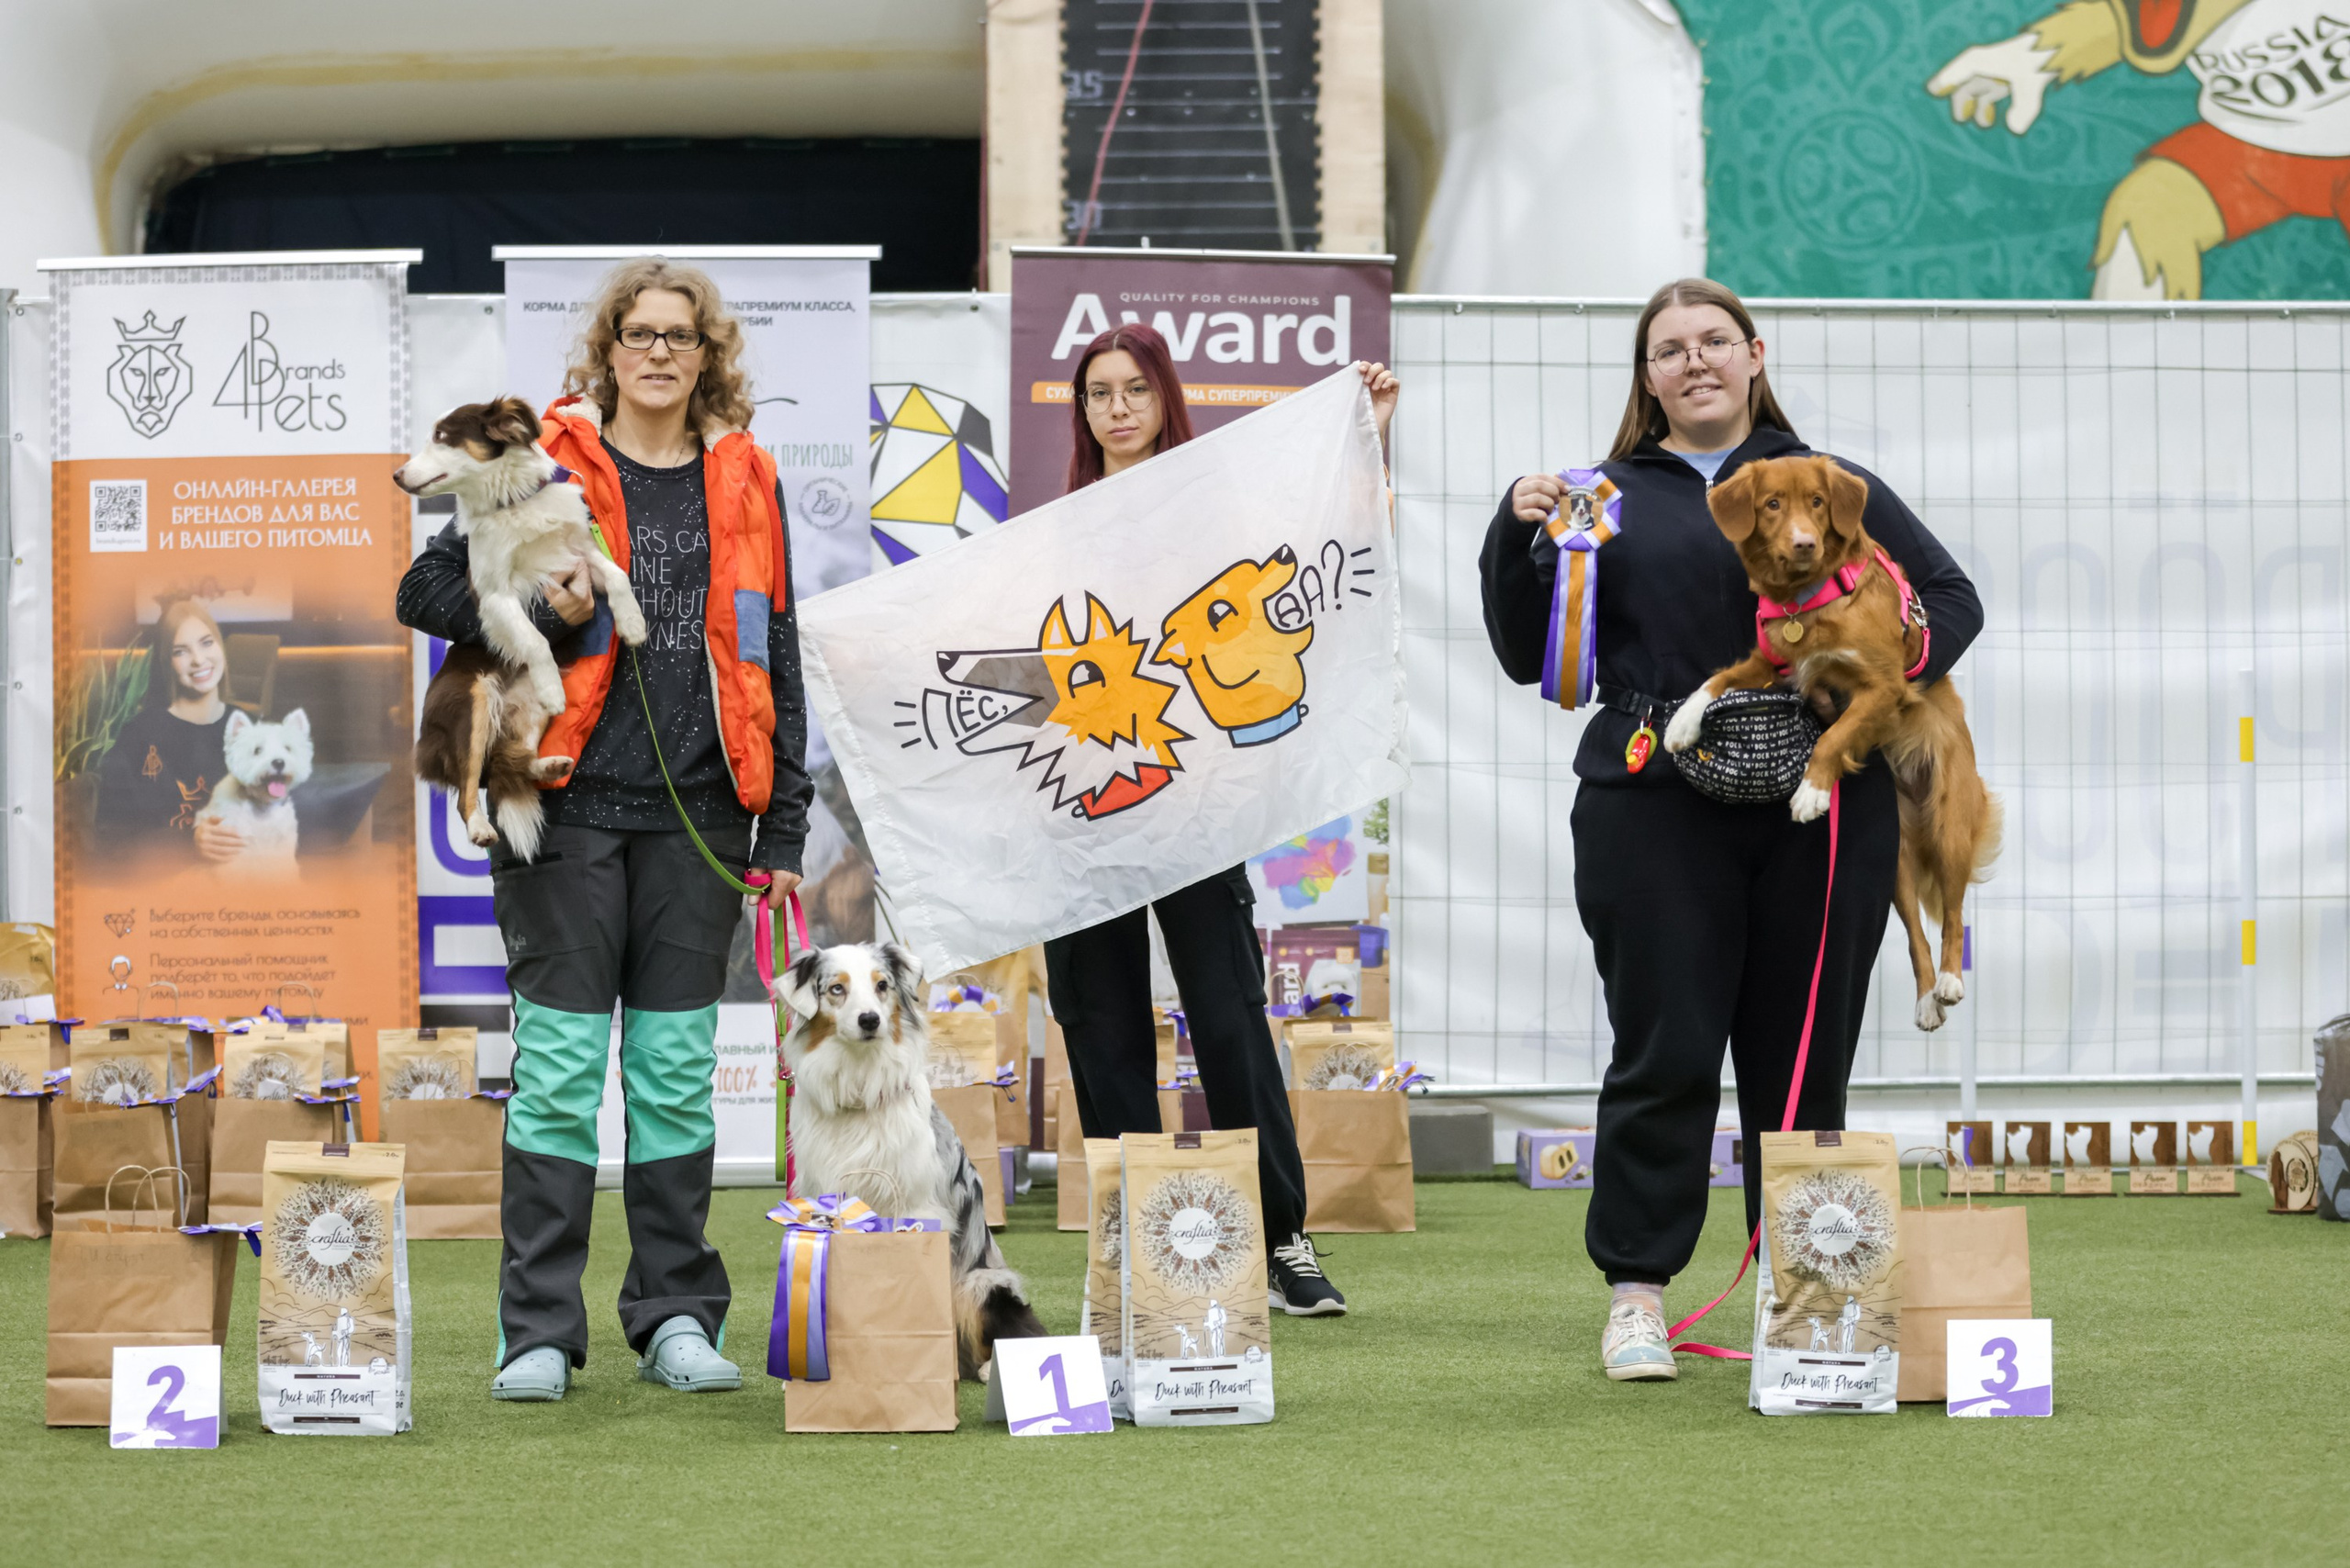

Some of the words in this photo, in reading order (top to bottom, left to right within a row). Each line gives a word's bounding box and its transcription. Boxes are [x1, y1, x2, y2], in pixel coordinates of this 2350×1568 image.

[2210, 35, 2350, 108] 2018
[523, 302, 566, 312] КОРМА
[724, 301, 801, 312] ТРАПРЕМИУМ
[804, 301, 856, 313] КЛАССА,
[1119, 292, 1185, 303] QUALITY
[1192, 294, 1222, 303] FOR
[1227, 295, 1320, 306] CHAMPIONS
[1050, 293, 1351, 366] Award
[1182, 388, 1205, 401] РМА
[1208, 389, 1292, 402] СУПЕРПРЕМИ
[782, 443, 853, 469] ПРИРОДЫ
[173, 478, 357, 499] ОНЛАЙН-ГАЛЕРЕЯ
[172, 504, 263, 524] БРЕНДОВ
[268, 503, 313, 523] ДЛЯ
[319, 502, 360, 521] ВАС
[159, 532, 173, 550] И
[180, 529, 262, 549] ВАШЕГО
[268, 527, 373, 548] ПИТОМЦА
[676, 531, 709, 554] CA
[633, 555, 672, 584] INE
[632, 587, 708, 619] THOUT
[644, 620, 703, 651] KNES
[150, 908, 215, 924] Выберите
[277, 908, 361, 920] основываясь
[150, 929, 168, 939] на
[172, 924, 260, 938] собственных
[263, 925, 333, 937] ценностях
[150, 953, 252, 969] Персональный
[256, 955, 328, 966] помощник
[242, 972, 266, 981] что
[1277, 963, 1300, 1005] ard
[151, 988, 205, 1000] именно
[208, 988, 262, 1001] вашему
[713, 1042, 767, 1056] ЛАВНЫЙ
[717, 1065, 757, 1093] 100%
[1980, 1337, 2020, 1394] 3
[1038, 1352, 1070, 1416] 1
[1110, 1379, 1125, 1398] Du
[1155, 1382, 1181, 1401] Duck
[1184, 1382, 1204, 1397] with
[1209, 1379, 1257, 1399] Pheasant
[1781, 1372, 1809, 1390] Duck
[1810, 1375, 1831, 1392] with
[1835, 1373, 1883, 1394] Pheasant
[147, 1365, 185, 1428] 2
[279, 1388, 304, 1407] Duck
[307, 1390, 326, 1405] with
[330, 1388, 381, 1408] Pheasant
